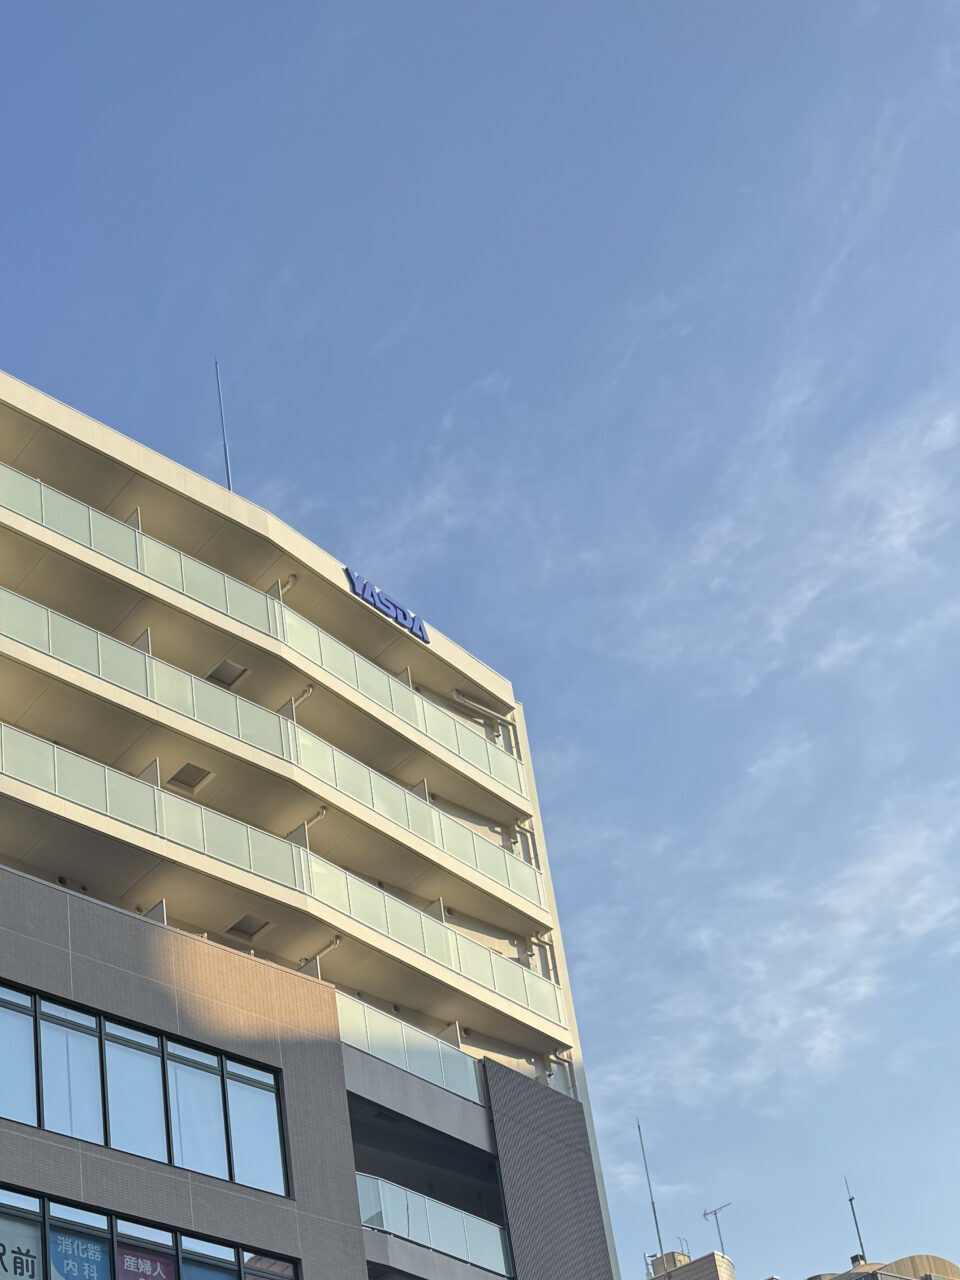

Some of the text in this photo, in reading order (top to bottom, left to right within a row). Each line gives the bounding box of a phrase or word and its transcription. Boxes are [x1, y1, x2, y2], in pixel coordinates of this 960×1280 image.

[342, 566, 430, 644] YASDA
[56, 1234, 102, 1261] 消化器
[122, 1253, 167, 1279] 産婦人
